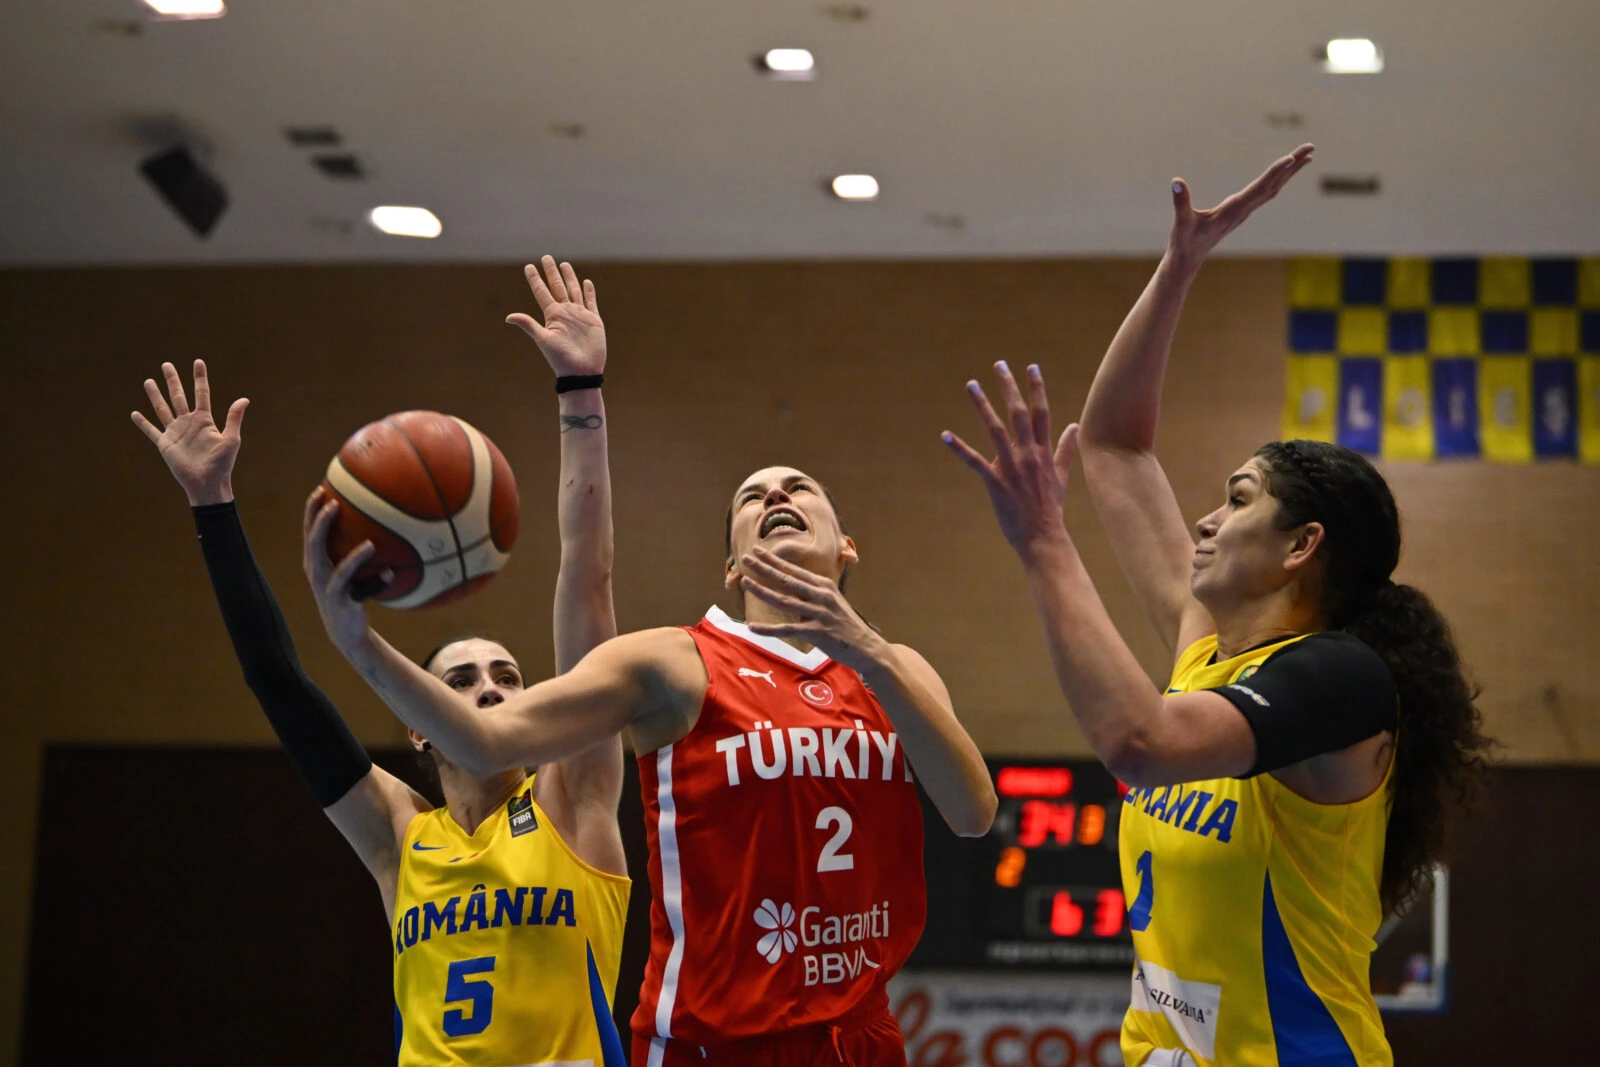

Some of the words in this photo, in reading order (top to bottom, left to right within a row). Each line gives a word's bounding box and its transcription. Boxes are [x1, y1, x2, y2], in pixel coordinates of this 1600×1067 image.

[513, 811, 532, 826] FIBA
[815, 806, 854, 872] 2
[800, 900, 889, 948] Garanti
[803, 945, 881, 987] BBVA
[442, 956, 496, 1037] 5
